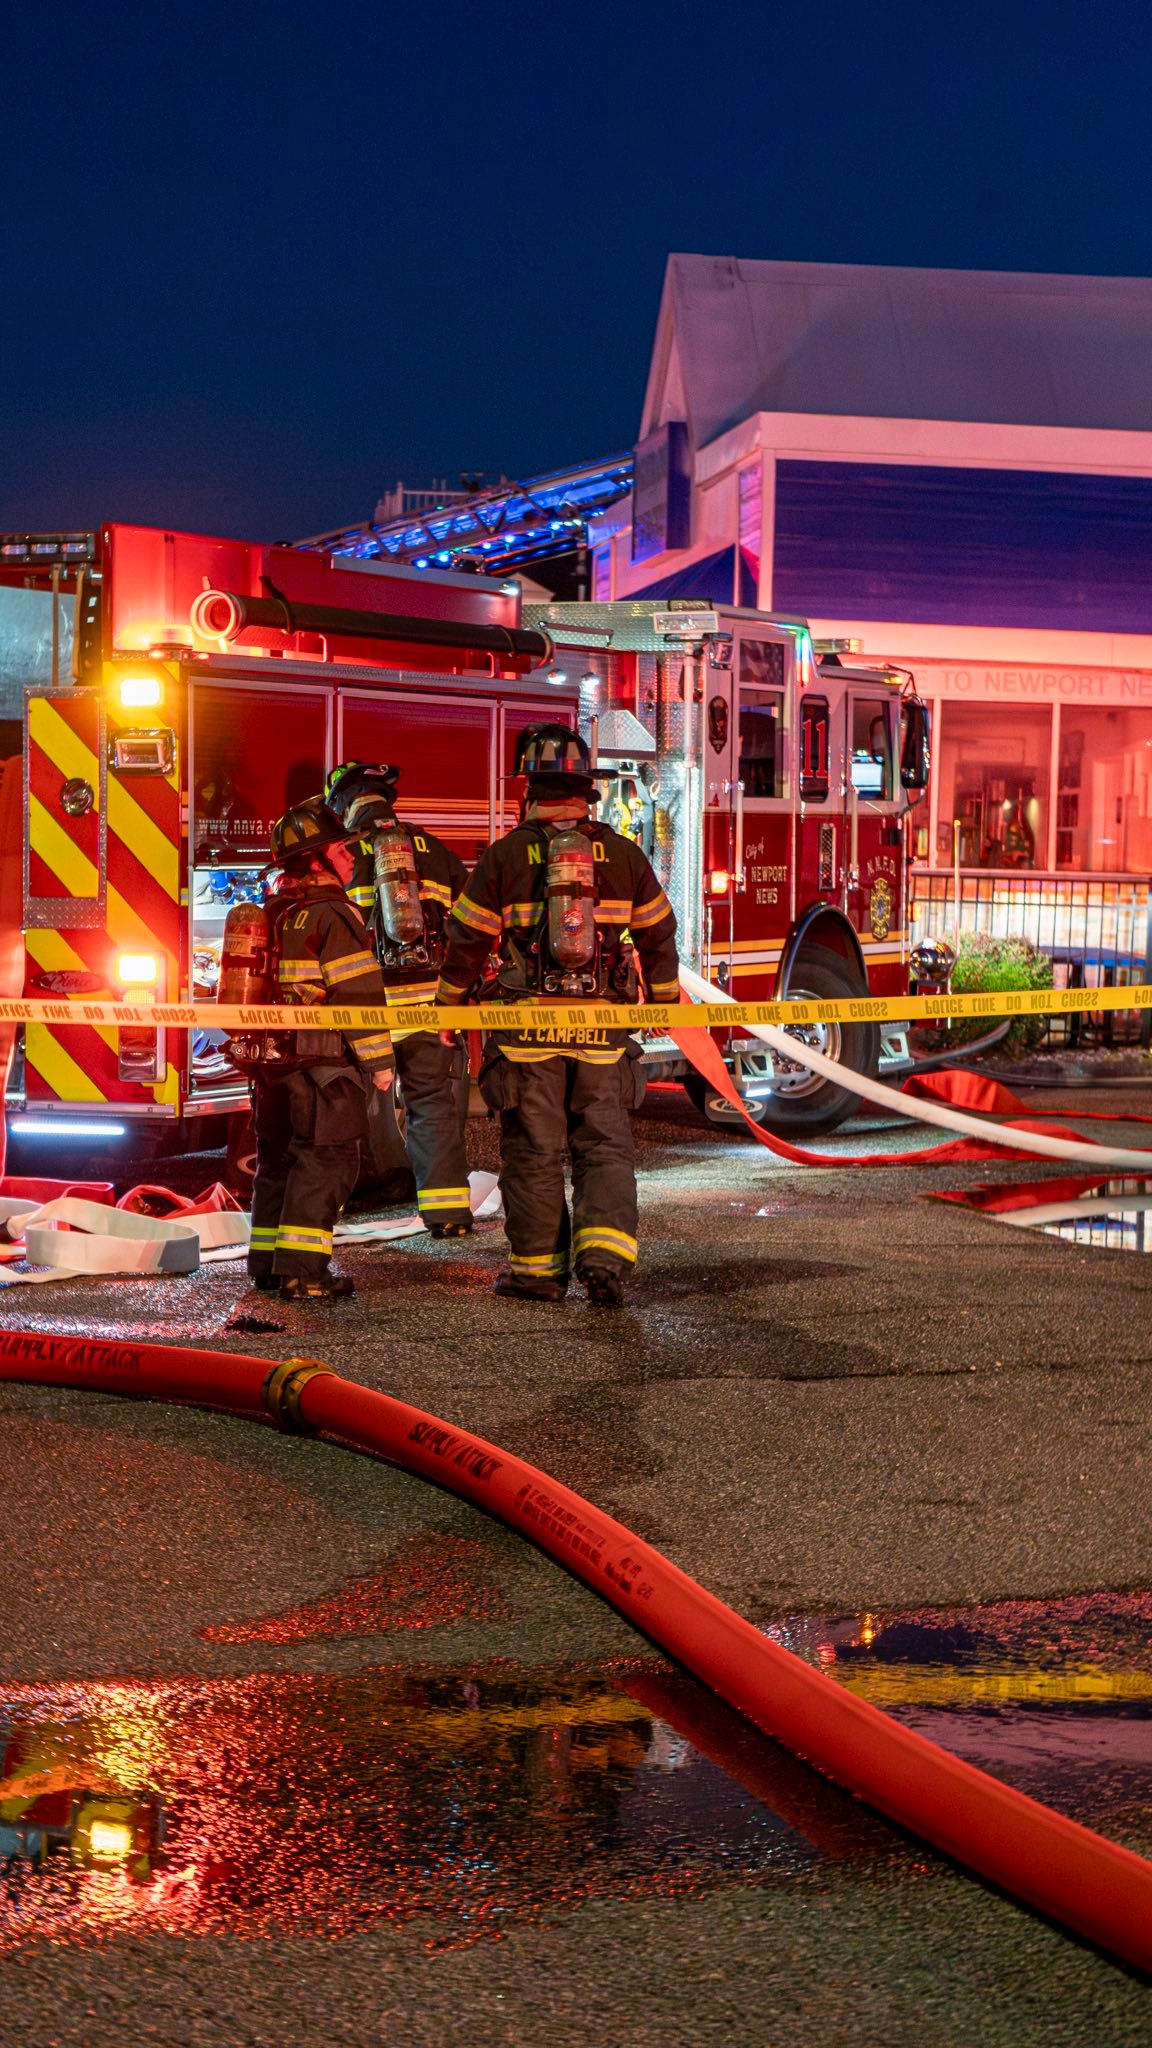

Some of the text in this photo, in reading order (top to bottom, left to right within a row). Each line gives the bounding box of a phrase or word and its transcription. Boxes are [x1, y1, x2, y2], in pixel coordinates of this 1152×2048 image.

[940, 670, 972, 690] TO
[985, 672, 1109, 696] NEWPORT
[802, 719, 829, 778] 11
[751, 865, 788, 883] NEWPORT
[756, 887, 778, 904] NEWS
[518, 1027, 610, 1045] J. CAMPBELL
